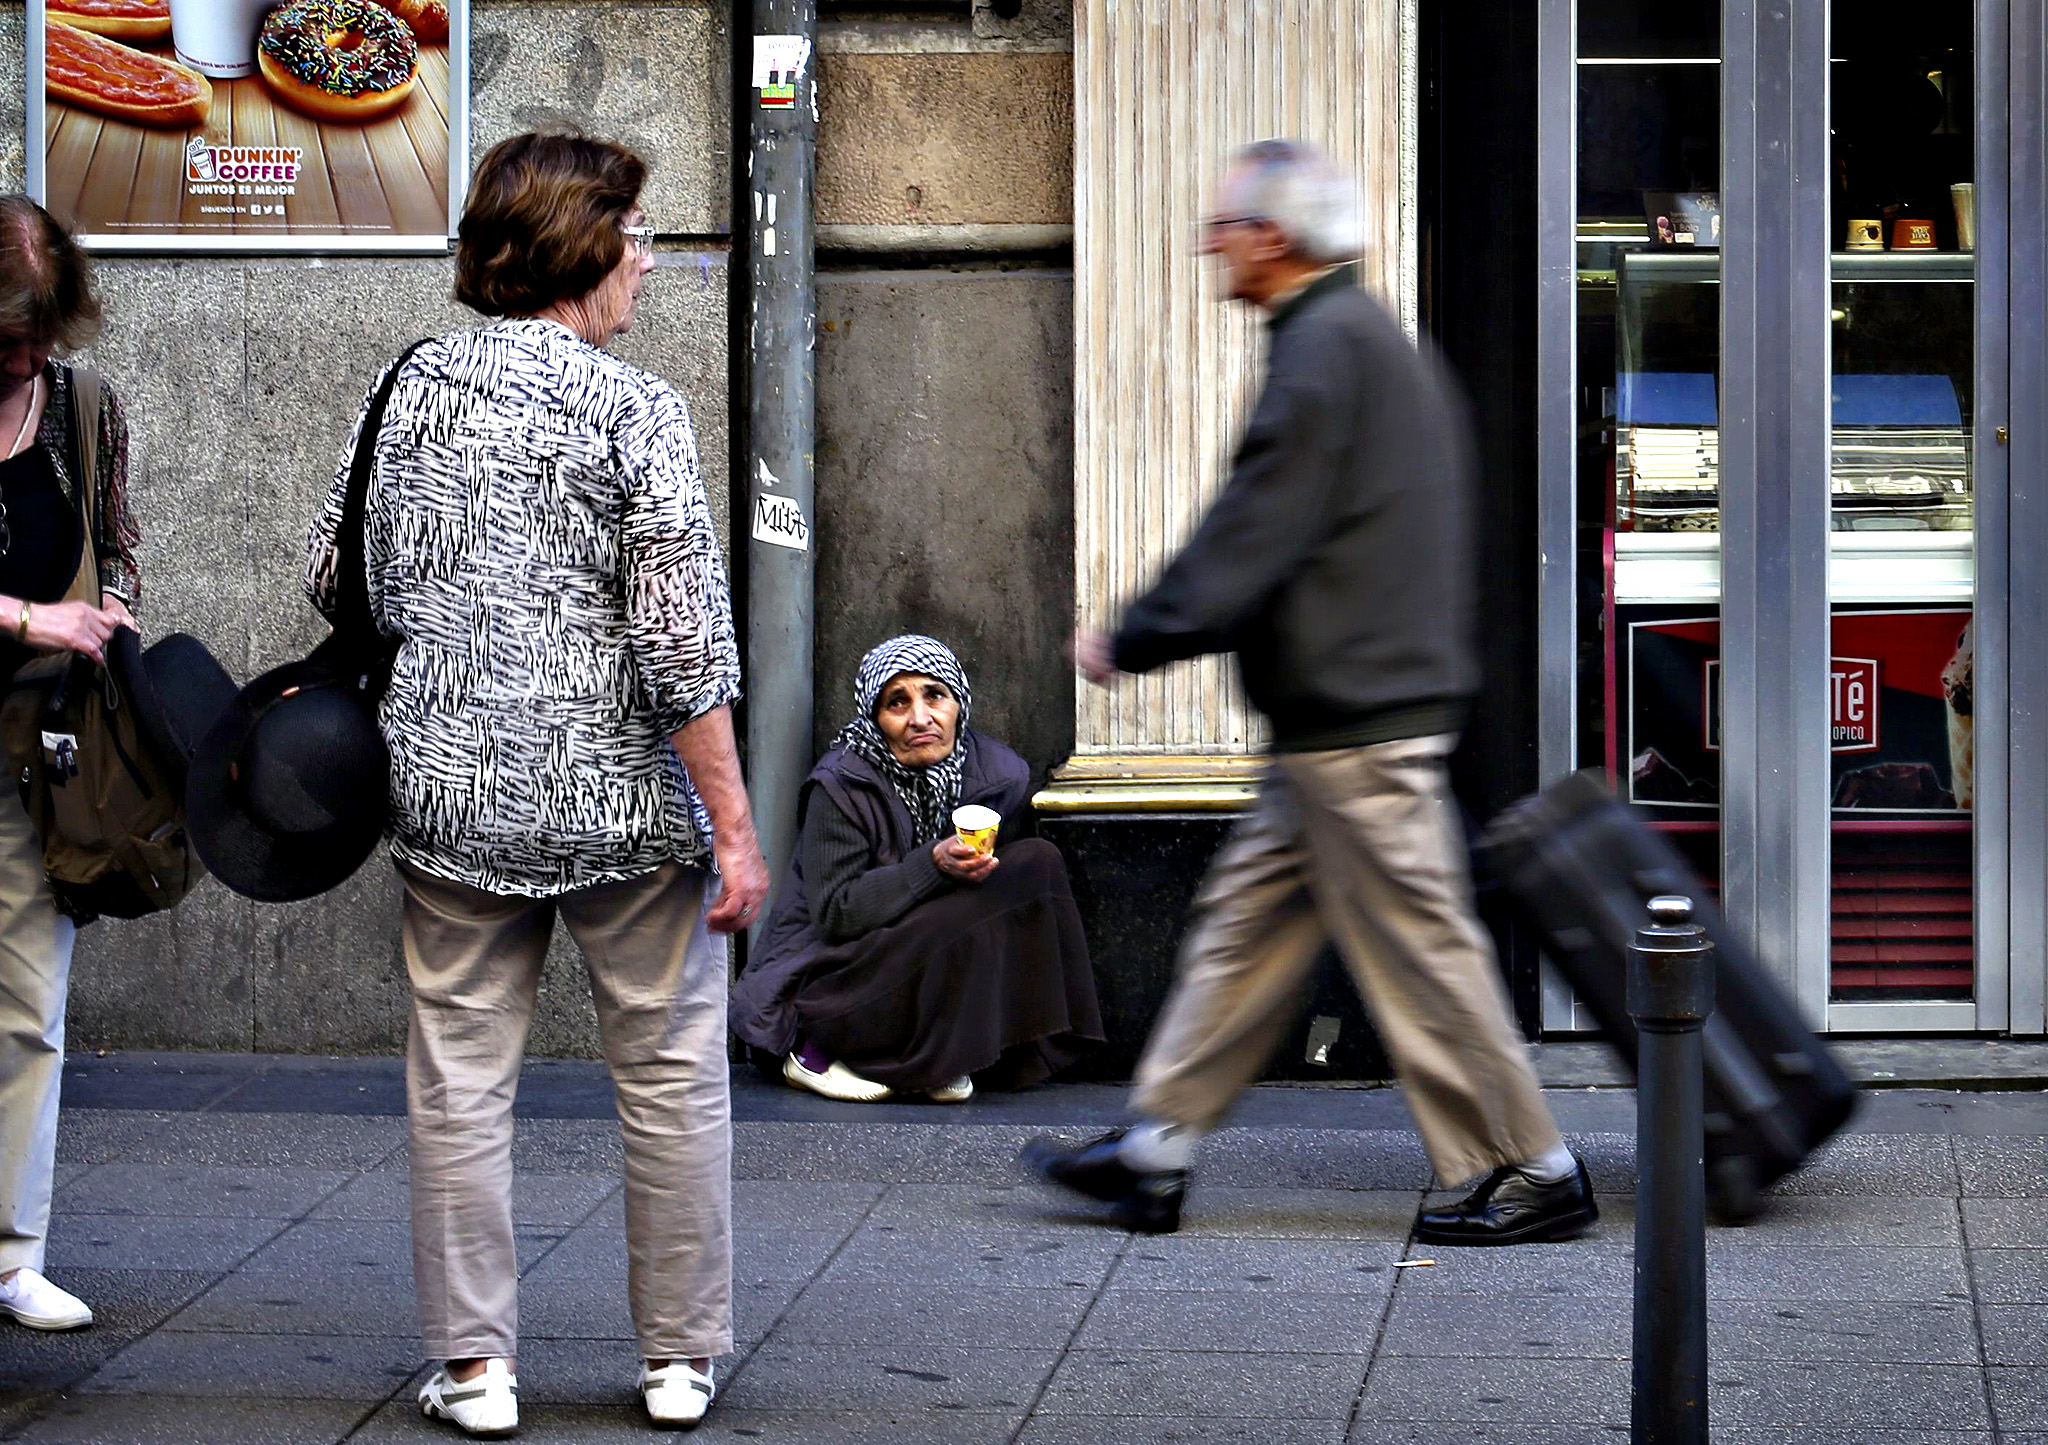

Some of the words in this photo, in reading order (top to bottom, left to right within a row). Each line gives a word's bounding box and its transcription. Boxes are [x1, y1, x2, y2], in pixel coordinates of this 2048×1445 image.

[219, 149, 301, 163] DUNKIN'
[219, 165, 295, 179] COFFEE
[188, 185, 236, 195] JUNTOS
[238, 185, 252, 195] ES
[255, 185, 295, 195] MEJOR
[1831, 670, 1864, 722] Té
[1831, 726, 1864, 740] OPICO
